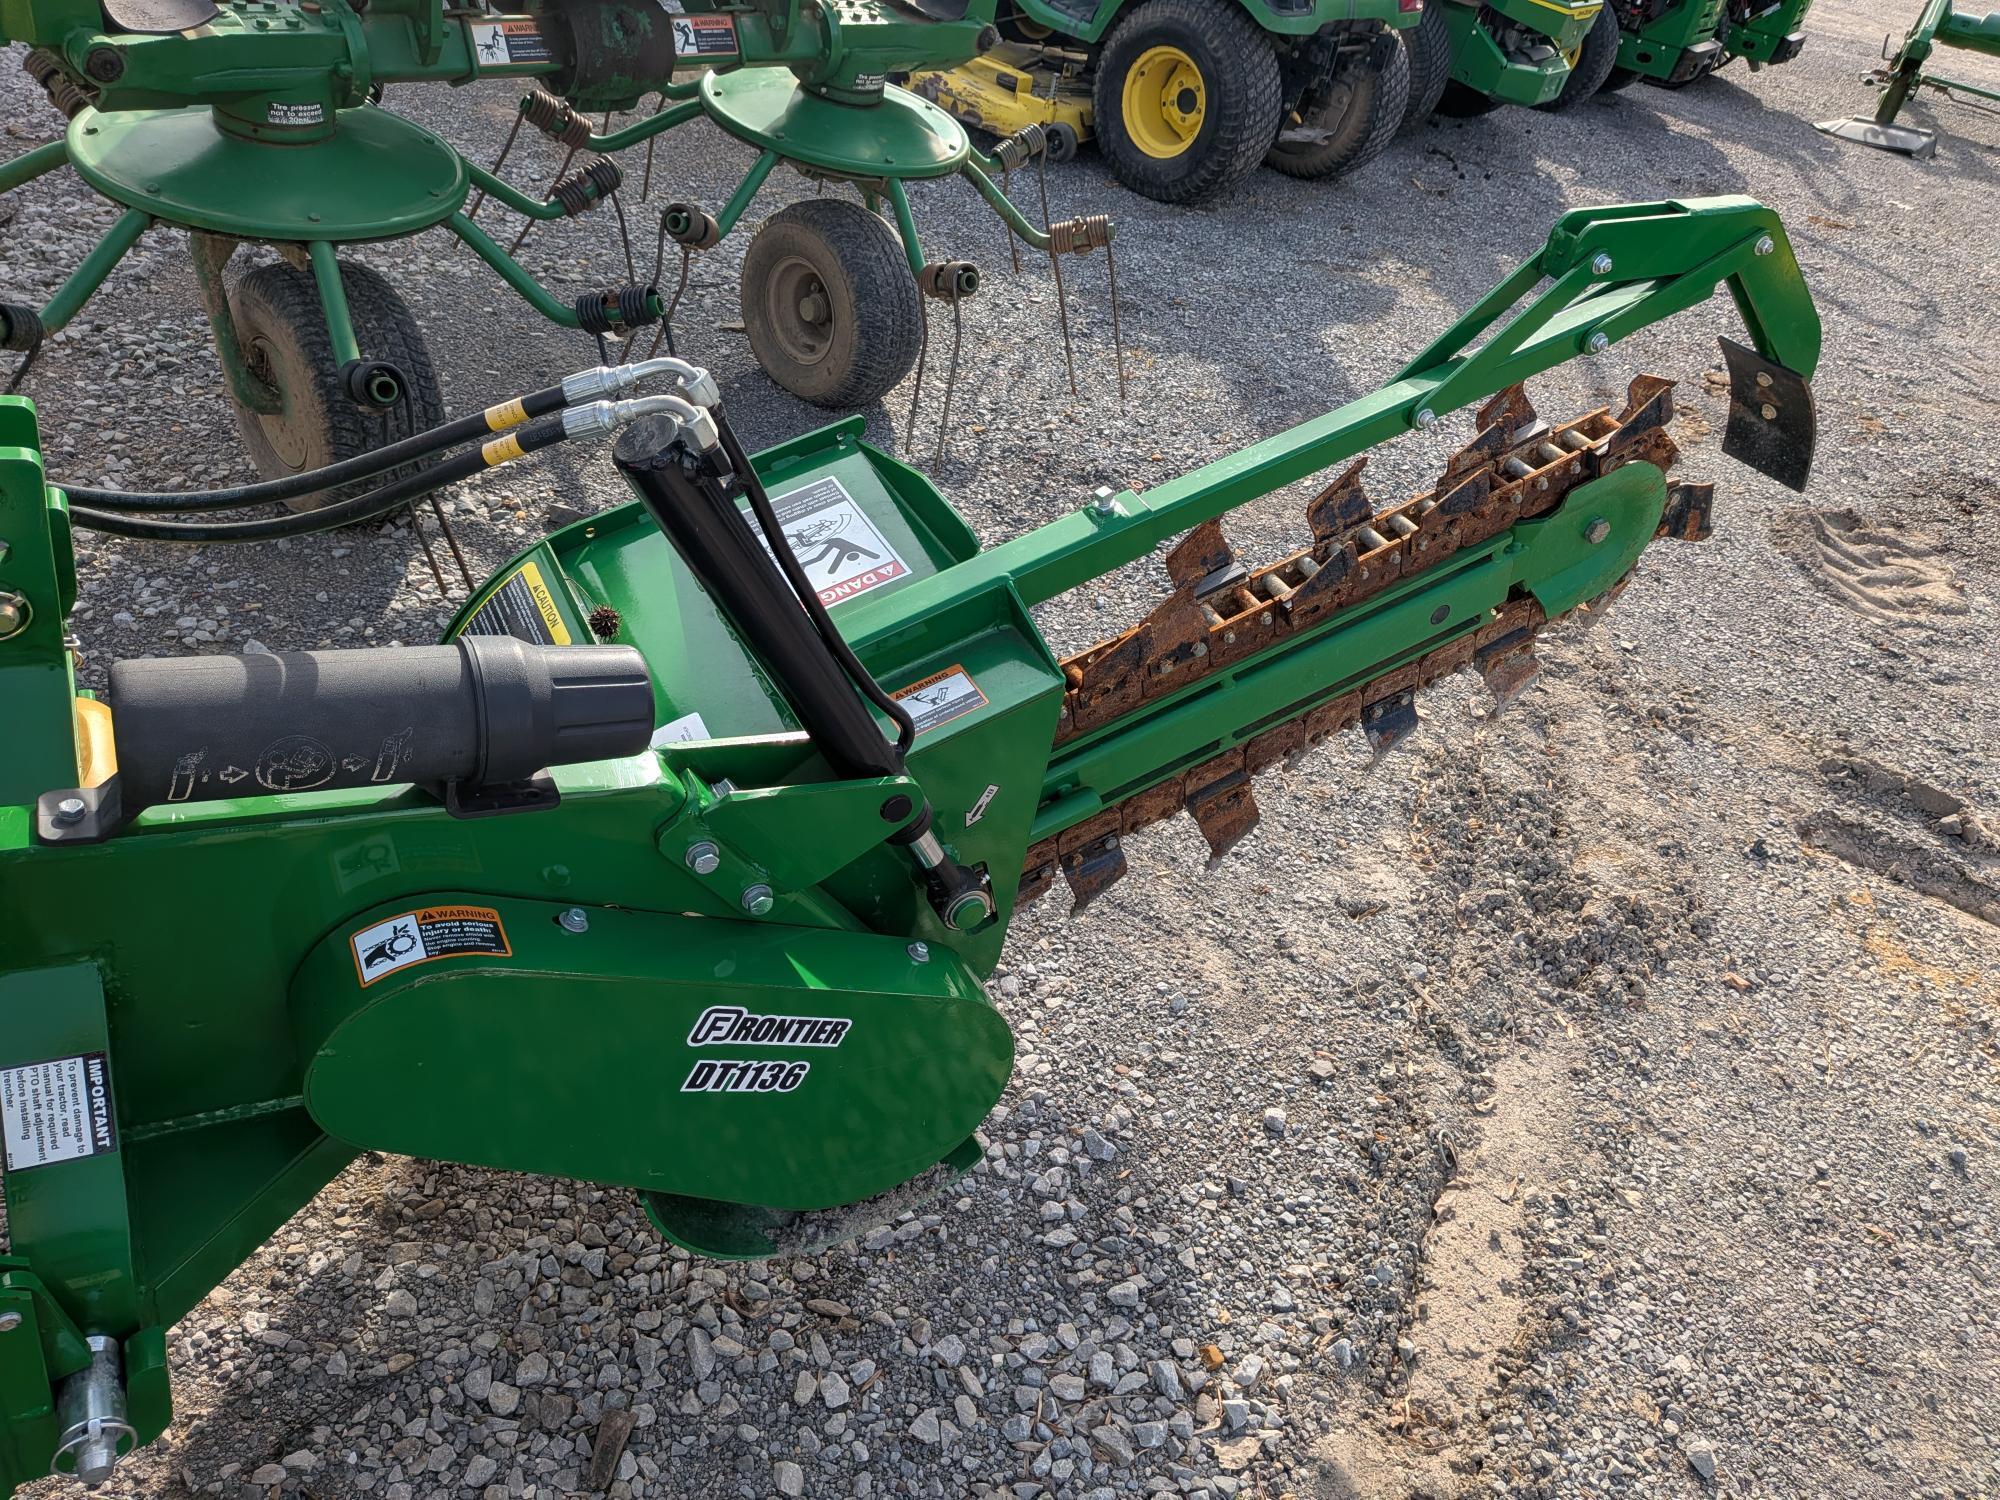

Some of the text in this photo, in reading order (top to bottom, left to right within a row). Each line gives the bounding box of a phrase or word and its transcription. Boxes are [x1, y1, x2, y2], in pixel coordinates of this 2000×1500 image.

[298, 109, 322, 117] exceed
[820, 574, 878, 602] DANG
[536, 590, 559, 628] CAUTION
[902, 672, 949, 696] WARNING
[422, 928, 449, 936] injury
[436, 910, 495, 920] WARNING
[689, 1007, 850, 1046] FRONTIER
[3, 1072, 14, 1111] trencher.
[683, 1062, 809, 1091] DT1136
[16, 1070, 32, 1140] before installing
[30, 1067, 48, 1161] PTO shaft adjustment
[42, 1065, 52, 1096] manual
[47, 1113, 59, 1150] required
[53, 1063, 71, 1137] your tractor, read
[68, 1060, 86, 1153] To prevent damage to
[88, 1059, 110, 1147] IMPORTANT
